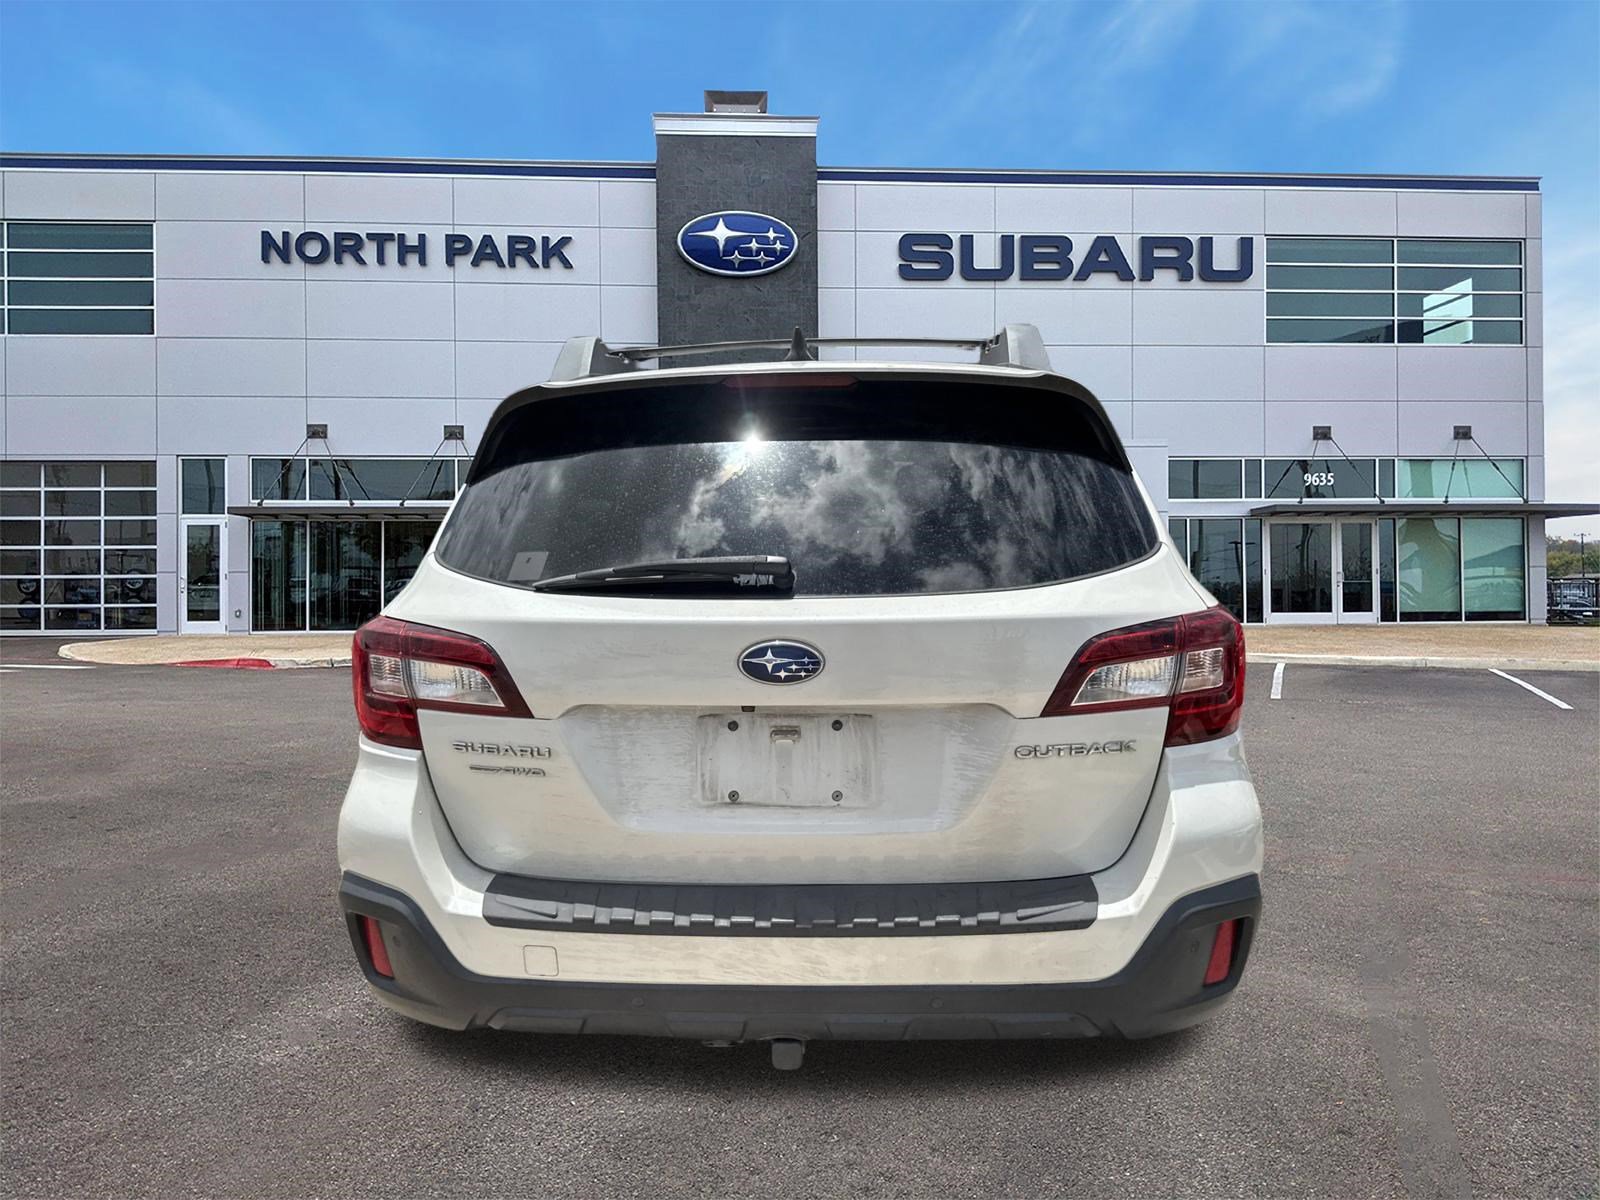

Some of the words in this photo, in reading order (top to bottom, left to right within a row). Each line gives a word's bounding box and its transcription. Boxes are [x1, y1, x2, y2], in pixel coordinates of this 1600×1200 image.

[260, 230, 427, 265] NORTH
[444, 233, 574, 270] PARK
[898, 233, 1254, 283] SUBARU
[1303, 472, 1335, 487] 9635
[452, 740, 552, 759] SUBARU
[1014, 739, 1137, 760] OUTBACK
